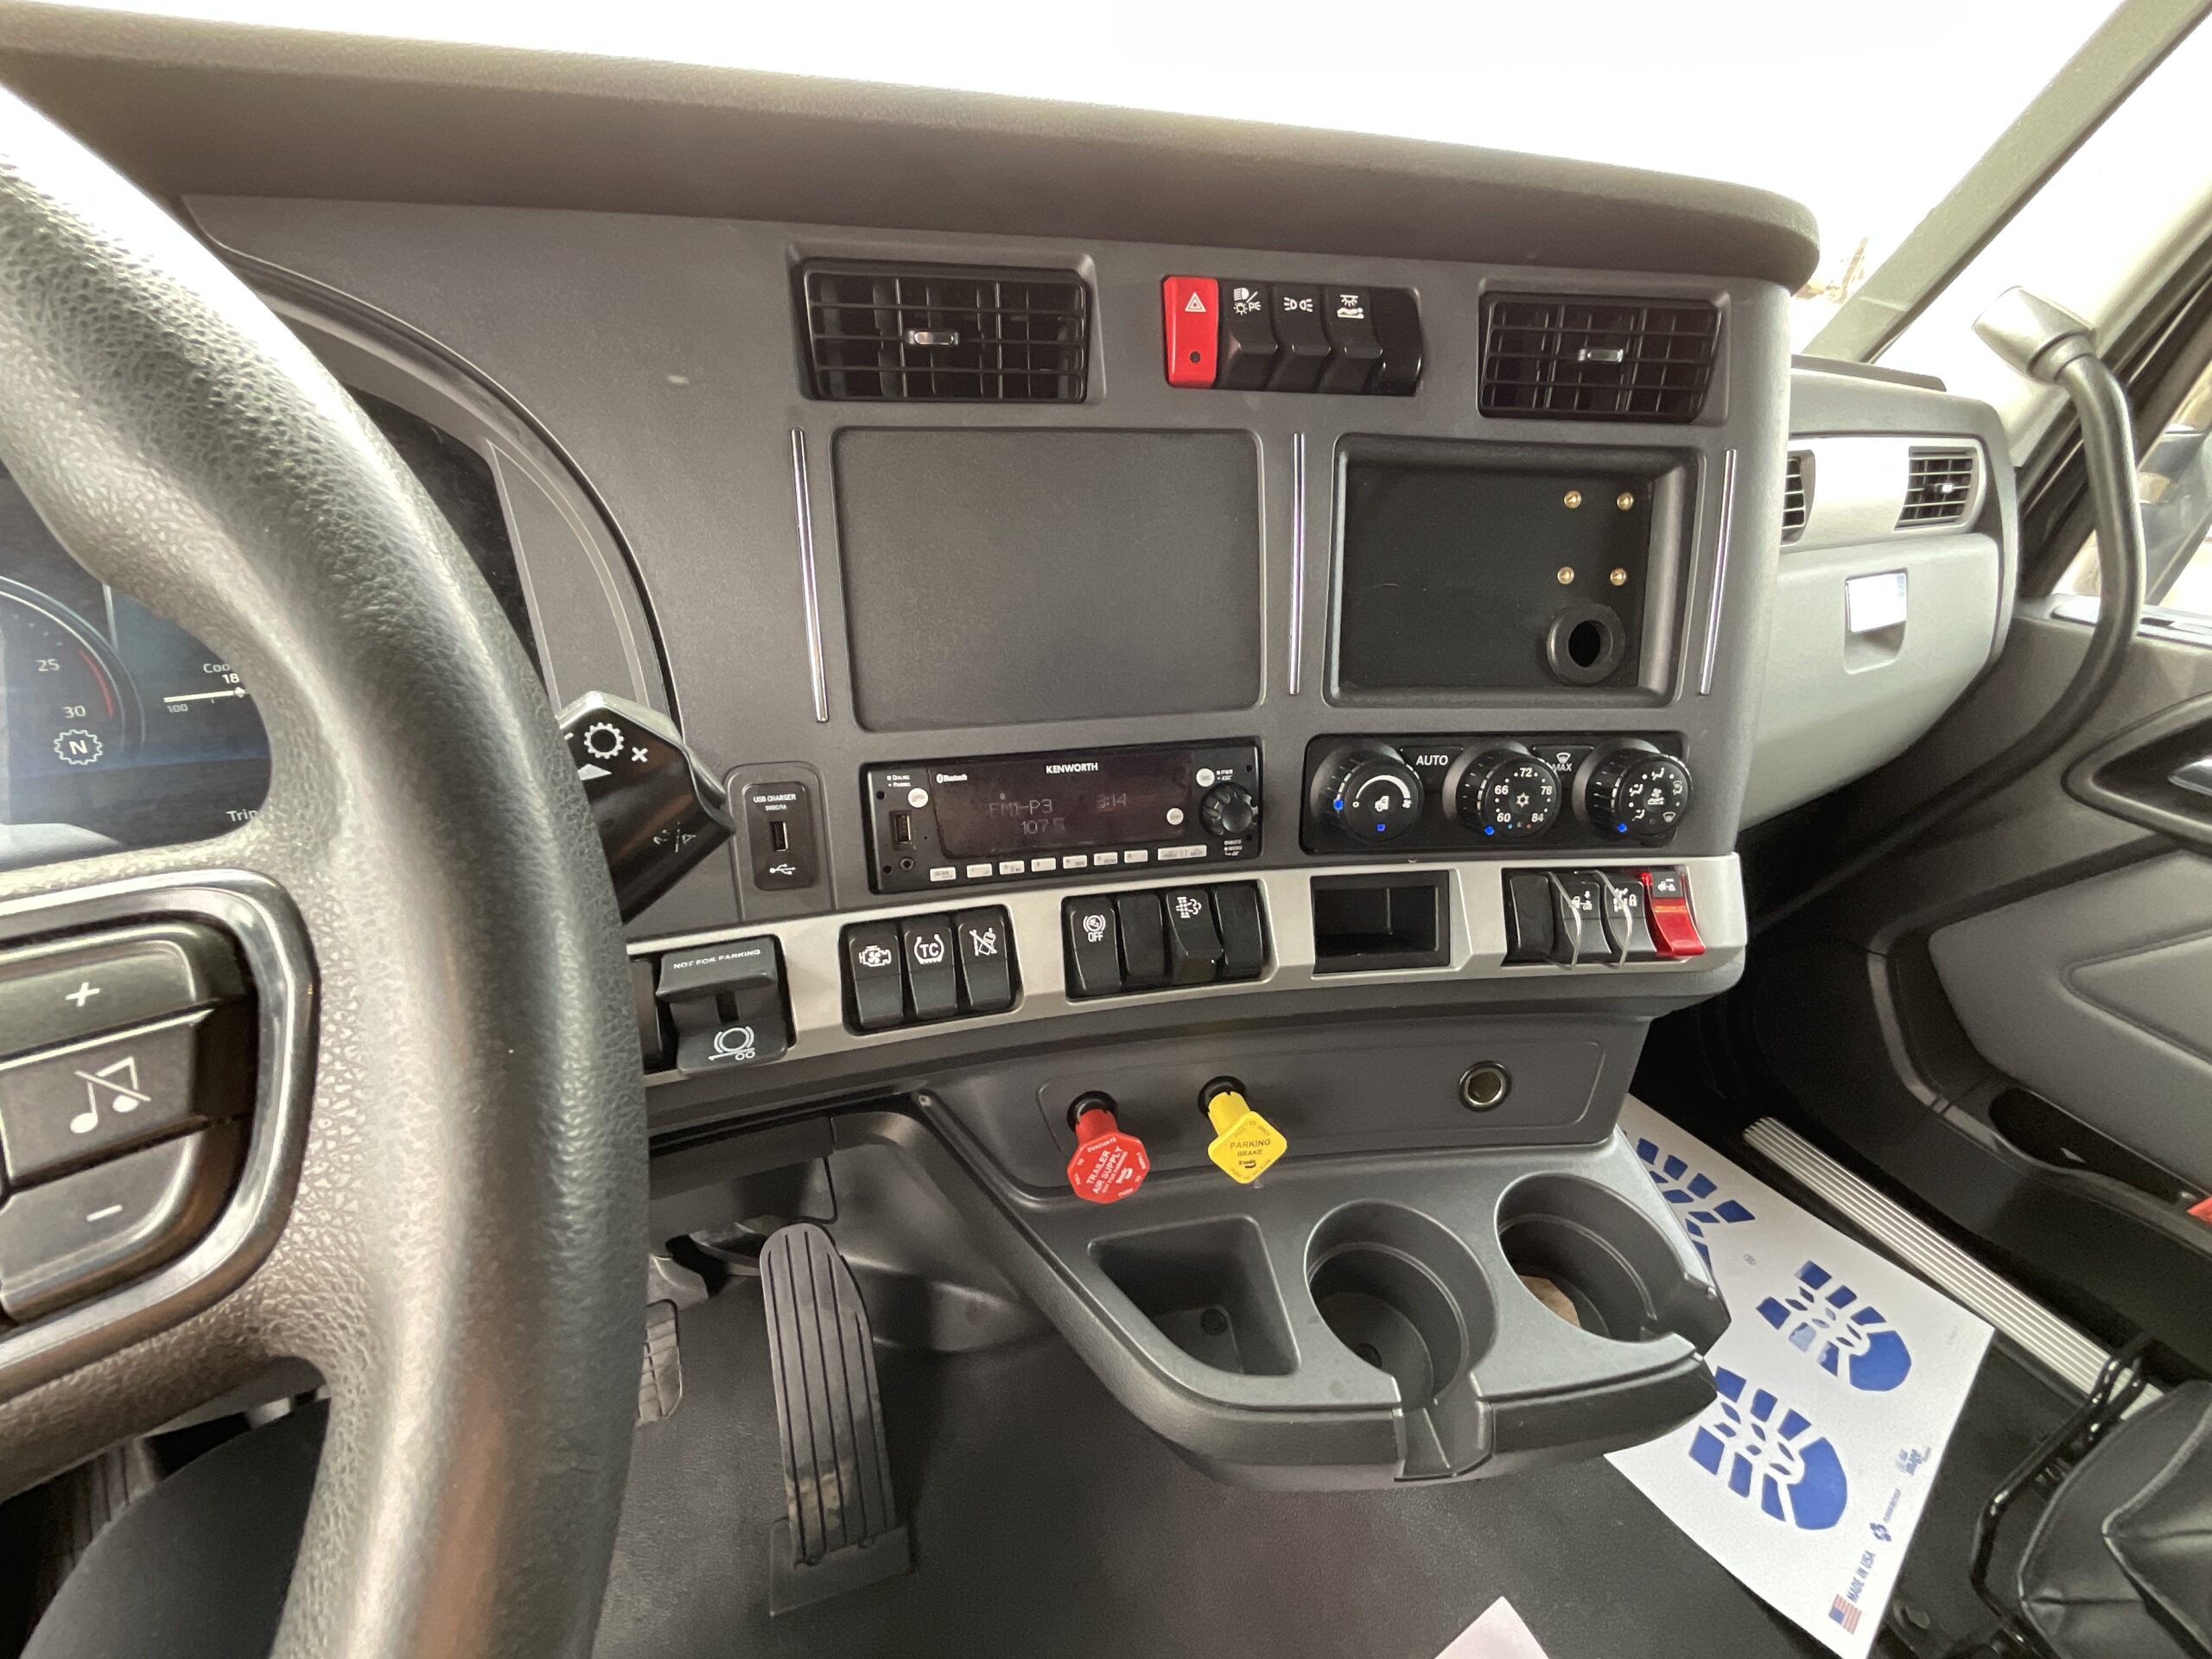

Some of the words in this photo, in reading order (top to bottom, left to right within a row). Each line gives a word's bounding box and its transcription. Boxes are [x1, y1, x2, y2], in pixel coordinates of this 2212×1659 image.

[37, 658, 60, 672] 25
[63, 705, 86, 719] 30
[167, 703, 188, 714] 100
[69, 741, 88, 755] N
[1415, 754, 1449, 766] AUTO
[1046, 762, 1098, 774] KENWORTH
[1519, 767, 1533, 778] 72
[1553, 763, 1573, 772] MAX
[1494, 785, 1509, 795] 66
[1541, 785, 1553, 796] 78
[753, 795, 767, 804] USB
[766, 793, 797, 802] CHARGER
[1096, 792, 1127, 810] 3:14
[1497, 812, 1511, 823] 60
[1531, 812, 1544, 823] 84
[1087, 931, 1103, 943] OFF
[918, 943, 940, 958] TC
[673, 960, 695, 969] NOT
[696, 957, 716, 965] FOR
[718, 949, 761, 961] PARKING
[1087, 1136, 1117, 1153] EVACUATE
[1230, 1138, 1271, 1149] PARKING
[1237, 1148, 1263, 1157] BRAKE
[1085, 1150, 1111, 1185] TRAILER
[1092, 1179, 1105, 1194] AIR
[1101, 1145, 1123, 1179] SUPPLY
[1861, 1550, 1876, 1569] USA
[1856, 1566, 1869, 1580] IN
[1847, 1577, 1865, 1604] MADE
